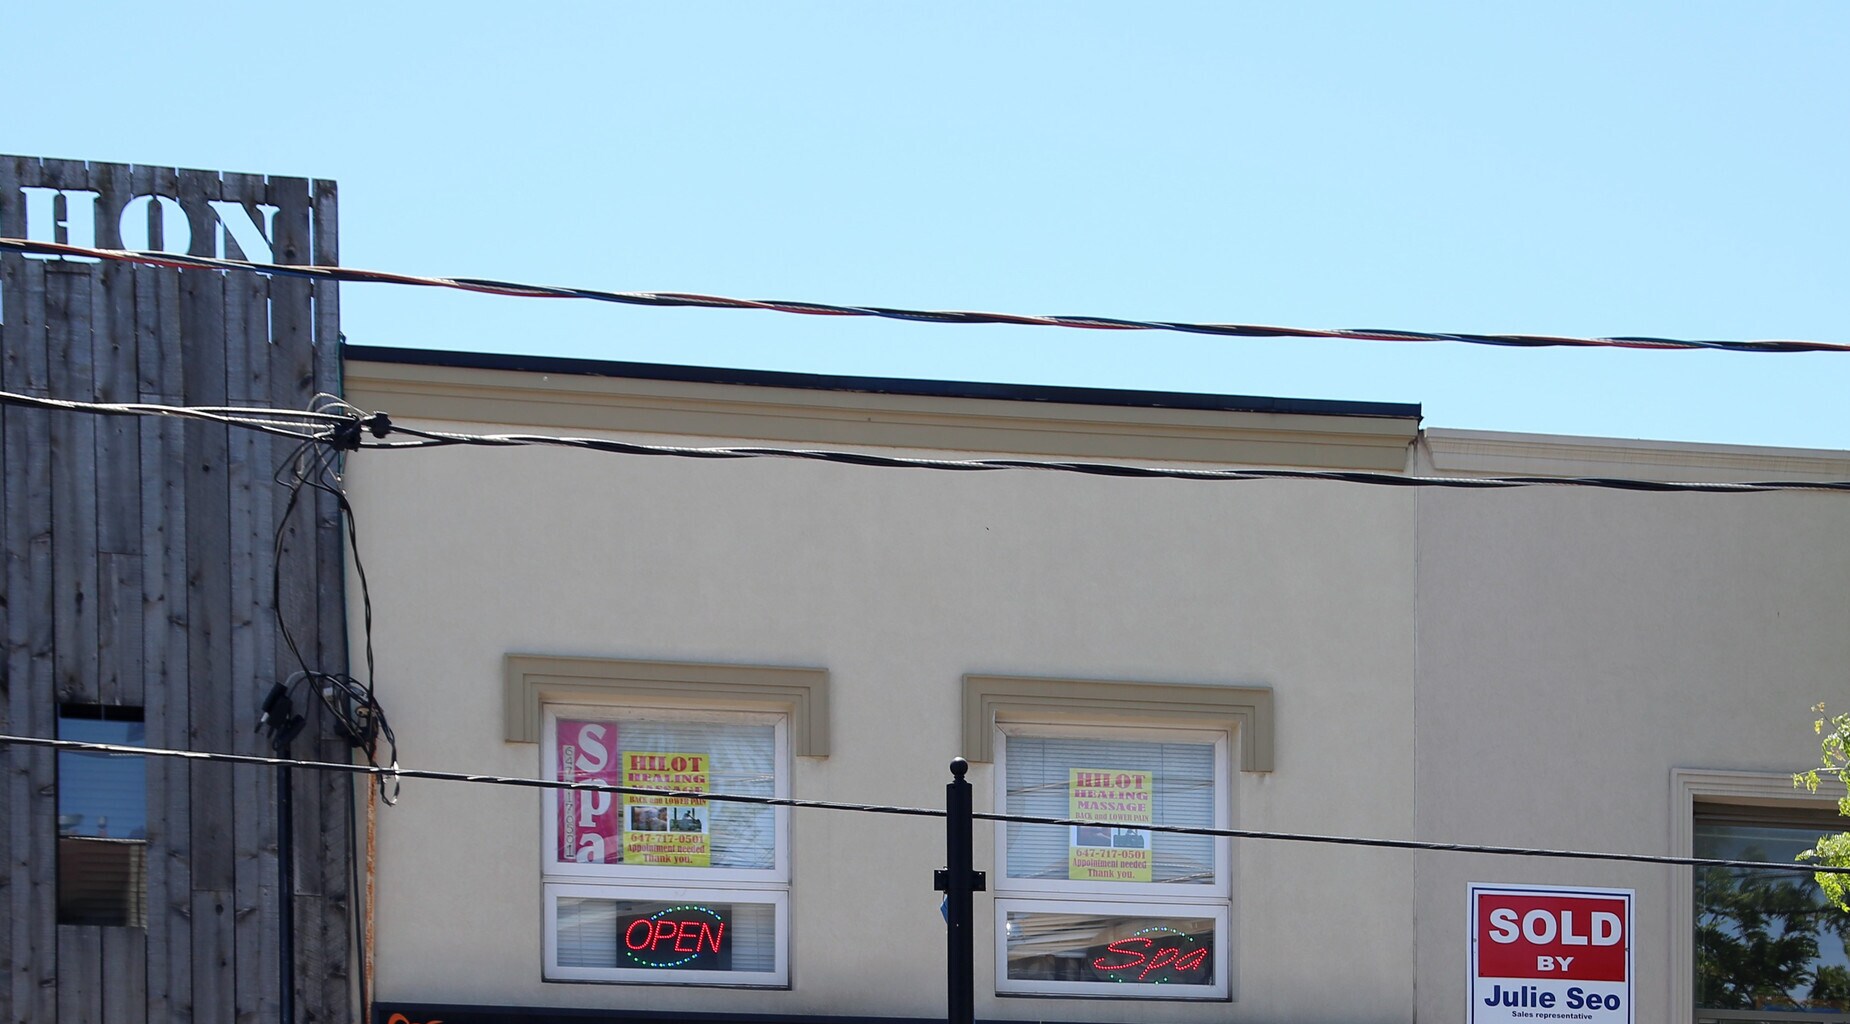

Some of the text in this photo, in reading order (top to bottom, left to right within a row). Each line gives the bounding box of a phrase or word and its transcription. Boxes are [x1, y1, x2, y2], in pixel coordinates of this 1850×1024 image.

[630, 755, 703, 772] HILOT
[628, 773, 706, 784] HEALING
[1076, 772, 1146, 789] HILOT
[1074, 789, 1148, 801] HEALING
[1077, 800, 1146, 812] MASSAGE
[1075, 812, 1149, 822] BACK and LOWER PAIN
[630, 834, 704, 843] 647-717-0501
[628, 844, 705, 853] Appointment needed
[1076, 849, 1146, 859] 647-717-0501
[643, 854, 671, 863] Thank
[1073, 858, 1147, 869] Appointment needed
[1087, 869, 1136, 879] Thank you.
[1488, 908, 1622, 946] SOLD
[625, 919, 724, 953] OPEN
[1093, 937, 1208, 980] Spa
[1537, 956, 1574, 972] BY
[1484, 985, 1620, 1010] Julie Seo
[1535, 1012, 1593, 1020] representative
